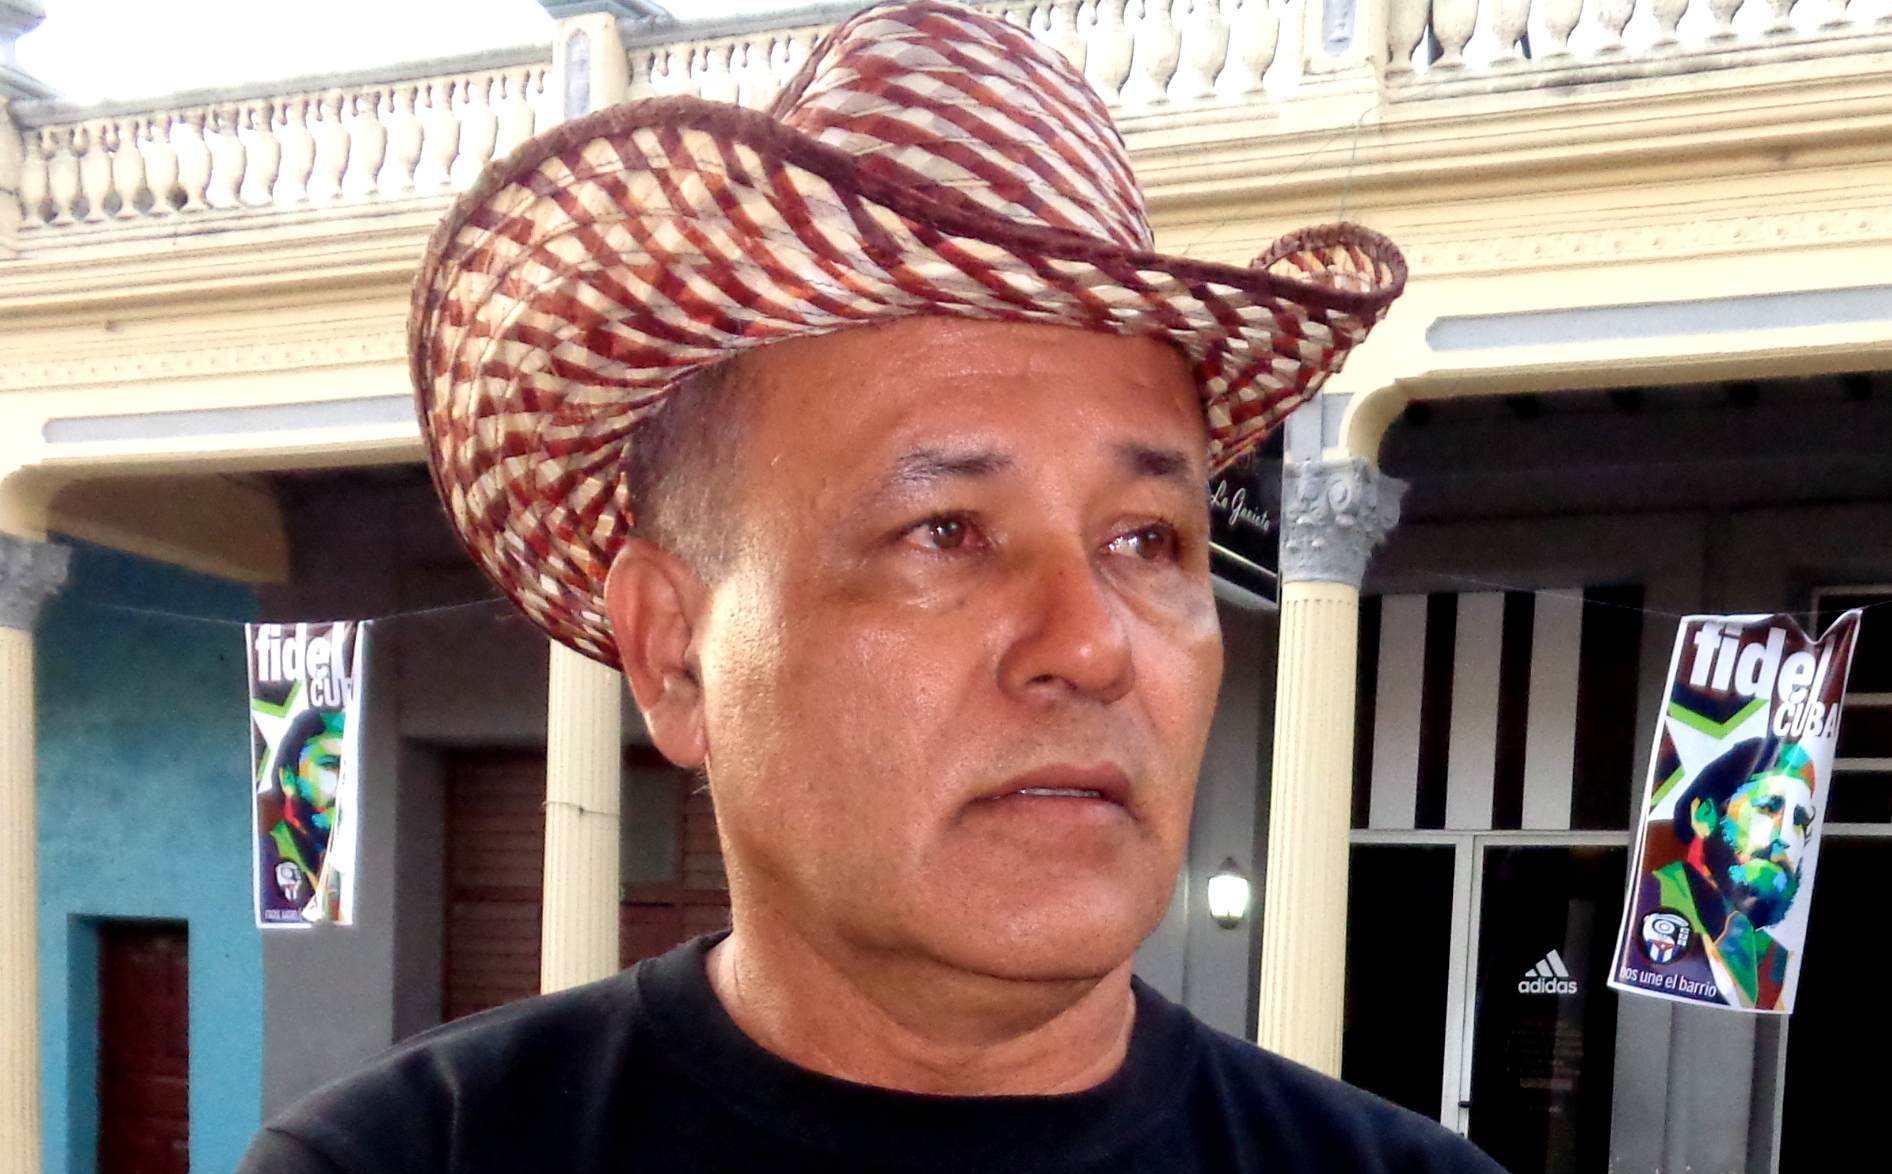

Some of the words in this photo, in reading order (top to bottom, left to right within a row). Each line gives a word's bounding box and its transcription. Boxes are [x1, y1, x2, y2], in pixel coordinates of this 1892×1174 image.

[255, 622, 346, 681] fidel
[1690, 622, 1836, 703] fidel
[310, 678, 353, 707] CU
[1773, 701, 1838, 738] CUBA
[1518, 977, 1577, 994] adidas
[1619, 967, 1638, 980] nos
[1640, 970, 1663, 988] une
[1665, 974, 1678, 989] el
[1679, 975, 1717, 997] barrio
